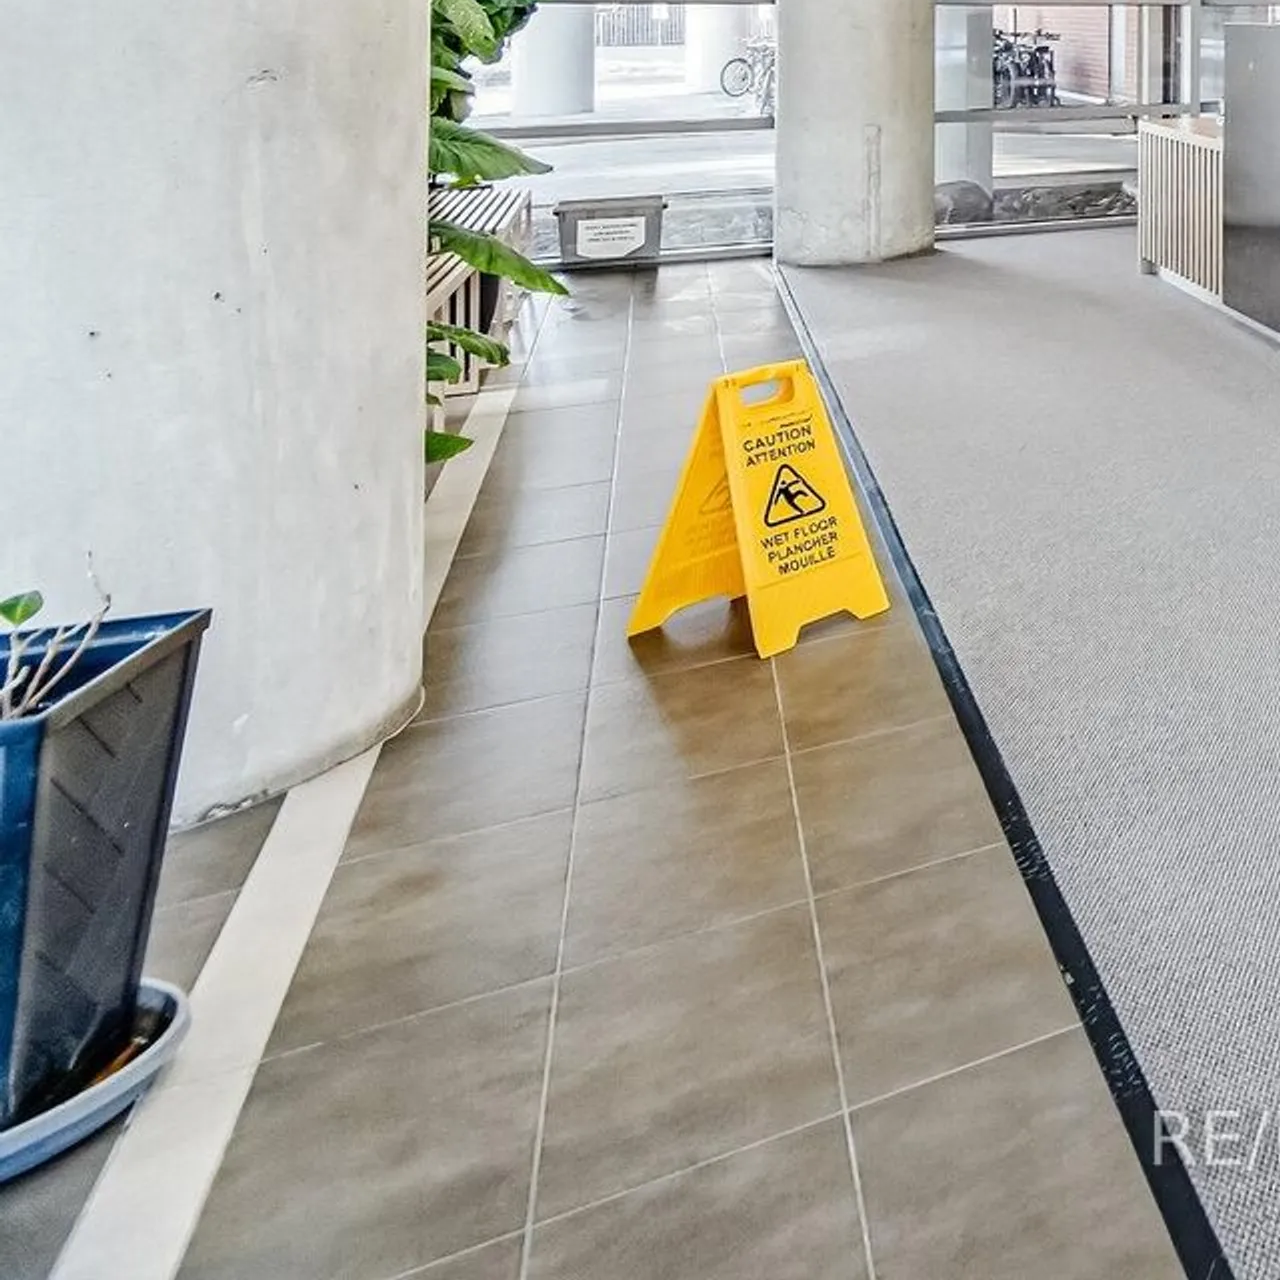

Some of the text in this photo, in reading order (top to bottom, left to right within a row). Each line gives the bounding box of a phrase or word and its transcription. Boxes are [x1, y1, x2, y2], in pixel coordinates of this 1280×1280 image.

[743, 425, 812, 453] CAUTION
[746, 438, 815, 467] ATTENTION
[760, 516, 838, 549] WET FLOOR
[768, 531, 838, 563] PLANCHER
